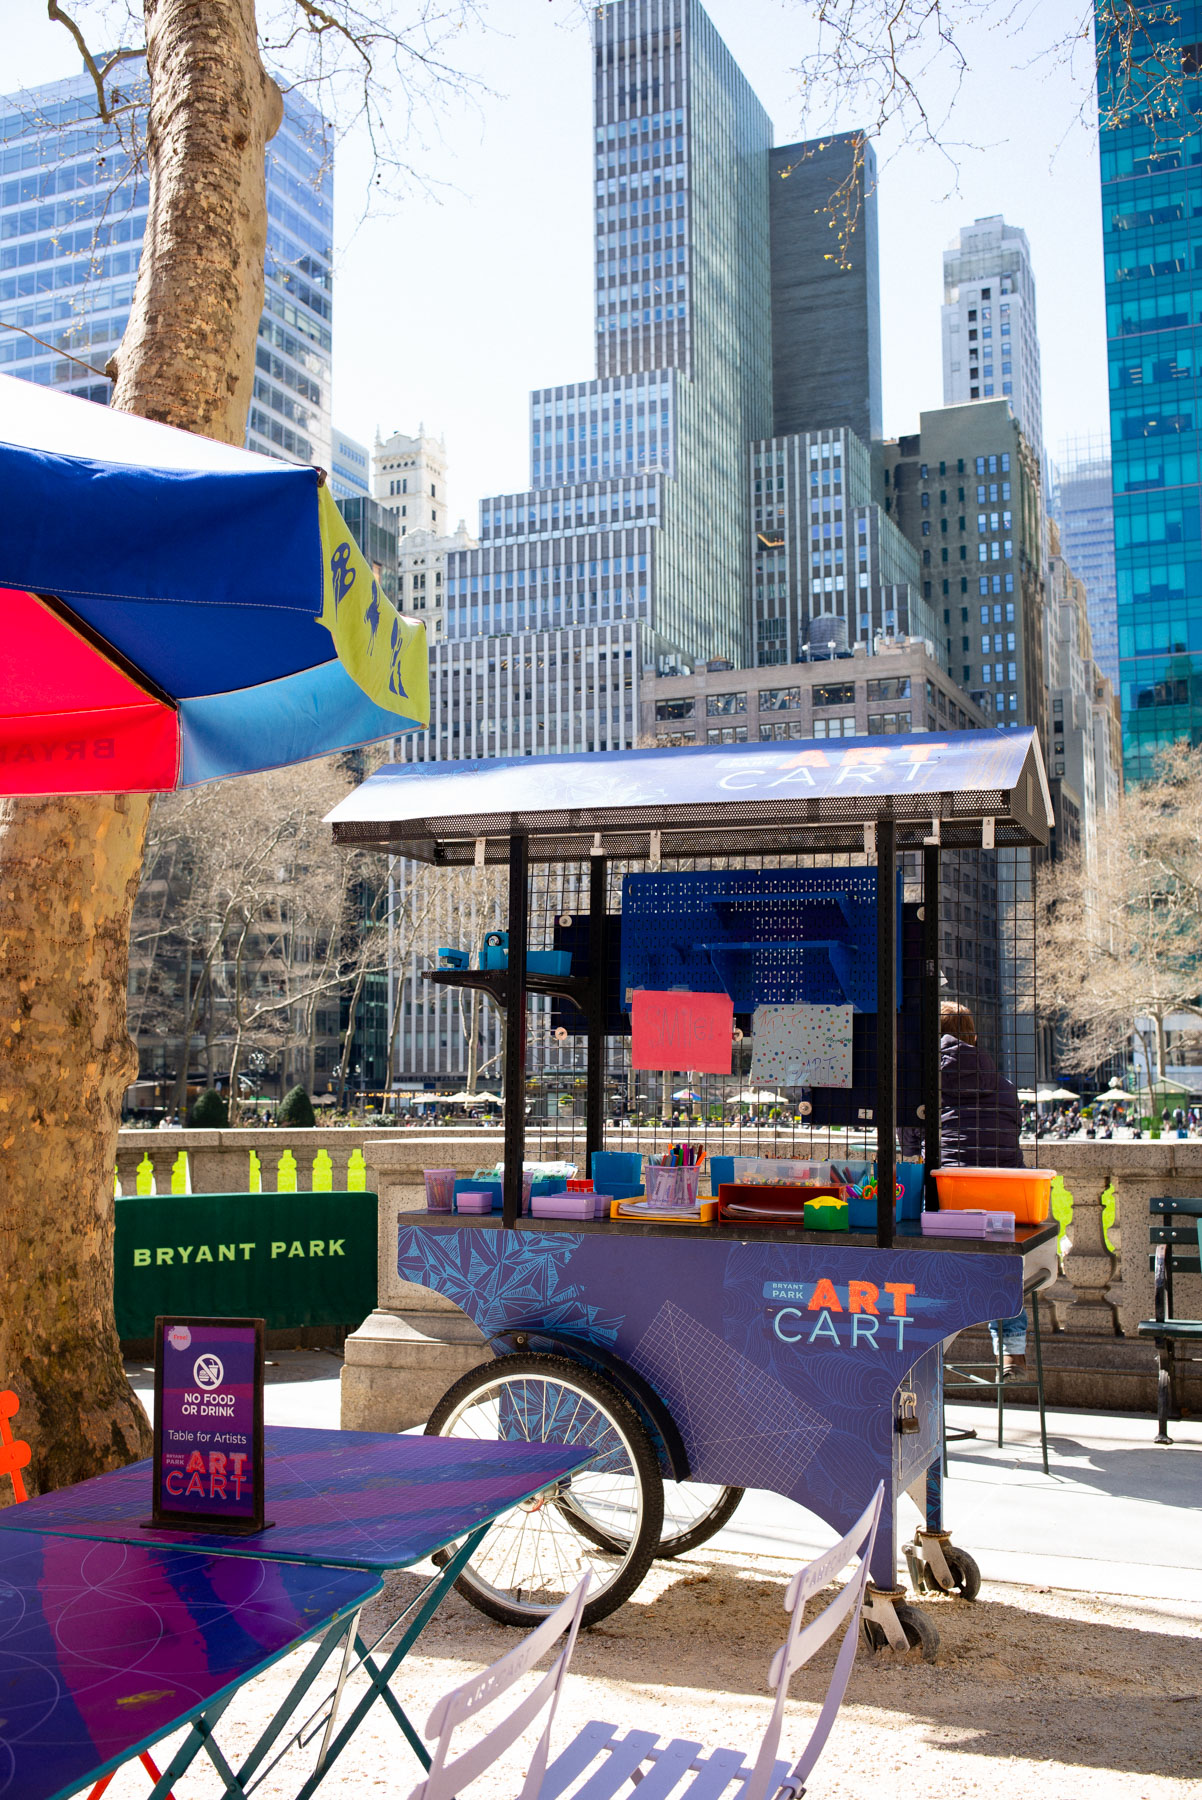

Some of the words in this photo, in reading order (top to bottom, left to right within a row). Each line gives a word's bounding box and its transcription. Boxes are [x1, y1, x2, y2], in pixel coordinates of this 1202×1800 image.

[776, 743, 949, 770] ART
[716, 760, 938, 790] CART
[785, 1048, 838, 1081] CART
[133, 1243, 256, 1267] BRYANT
[271, 1239, 346, 1259] PARK
[772, 1290, 804, 1299] PARK
[807, 1278, 916, 1317] ART
[773, 1307, 914, 1352] CART
[182, 1405, 198, 1415] OR
[200, 1405, 235, 1417] DRINK
[184, 1393, 201, 1404] NO
[203, 1393, 235, 1405] FOOD
[168, 1430, 194, 1442] Table
[197, 1431, 211, 1442] for
[214, 1433, 247, 1444] Artists
[186, 1450, 248, 1476] ART
[165, 1470, 247, 1500] CART
